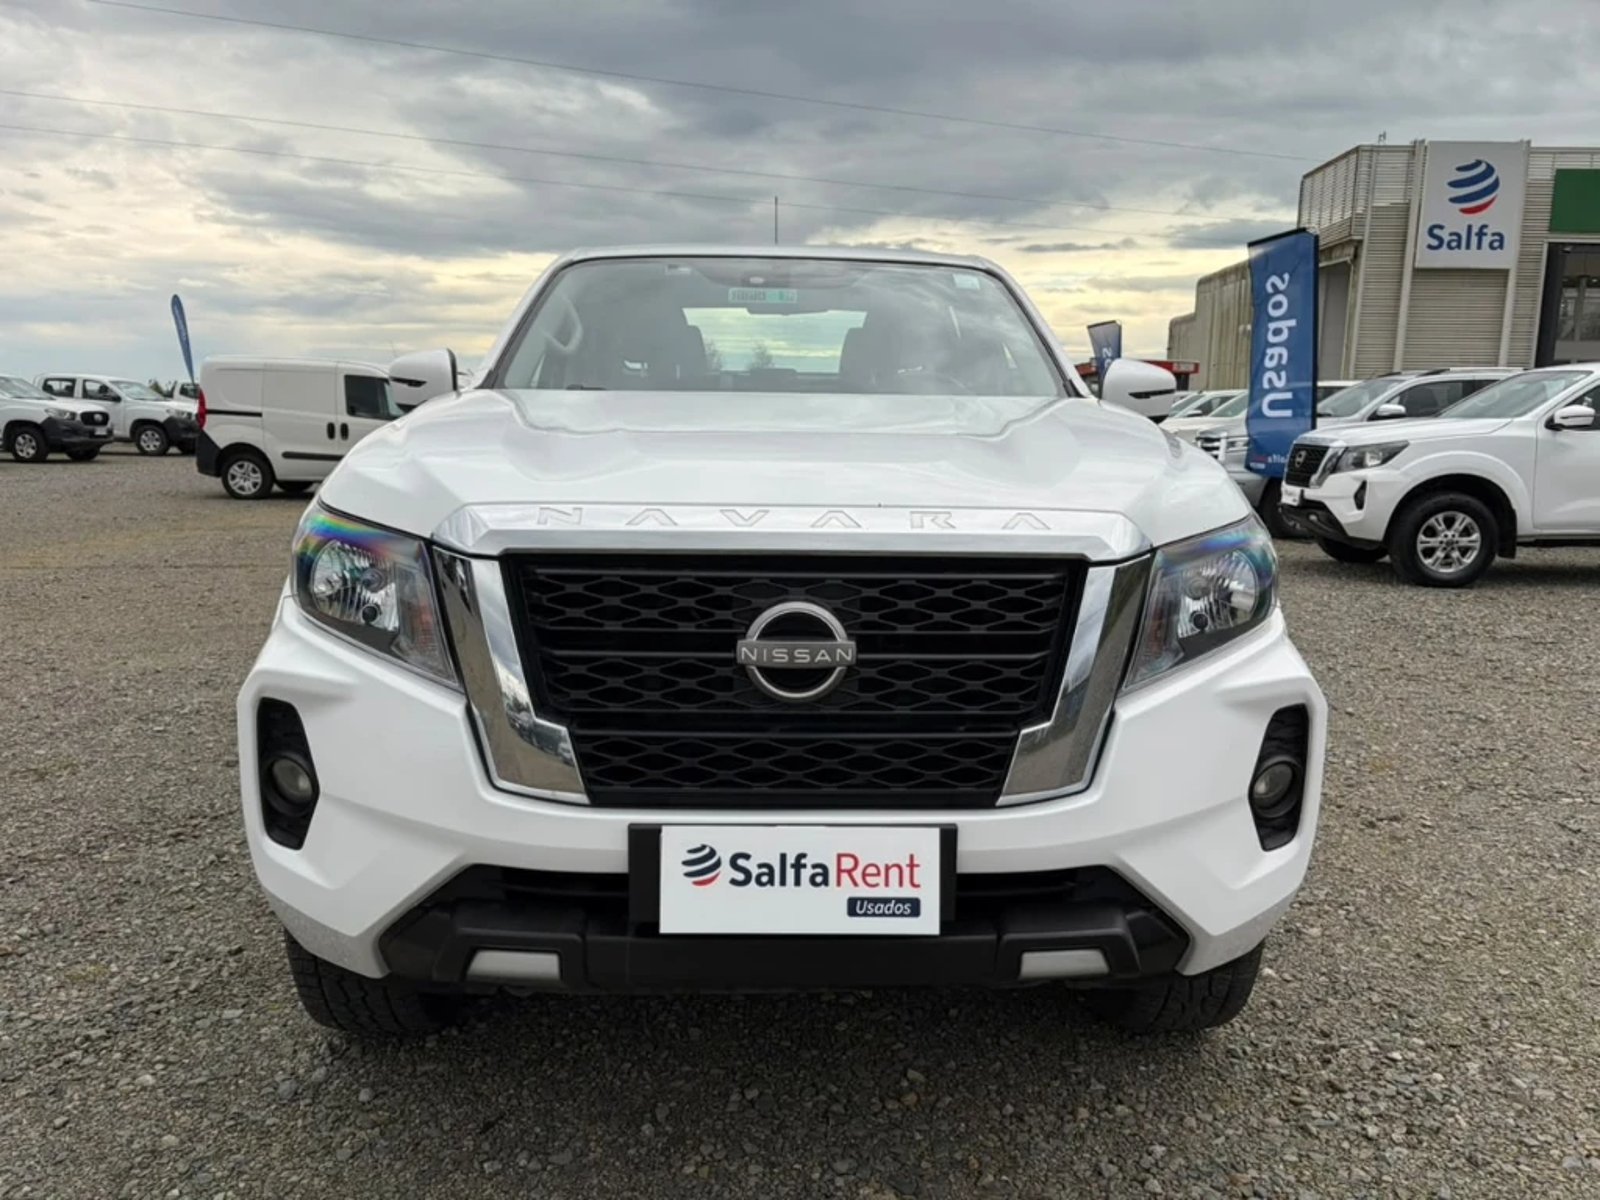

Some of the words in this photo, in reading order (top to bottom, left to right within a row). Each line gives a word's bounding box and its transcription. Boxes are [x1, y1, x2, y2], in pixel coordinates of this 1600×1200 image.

[1426, 223, 1505, 251] Salfa
[537, 507, 1052, 530] NAVARA
[741, 647, 853, 663] NISSAN
[729, 852, 921, 888] SalfaRent
[855, 899, 912, 916] Usados
